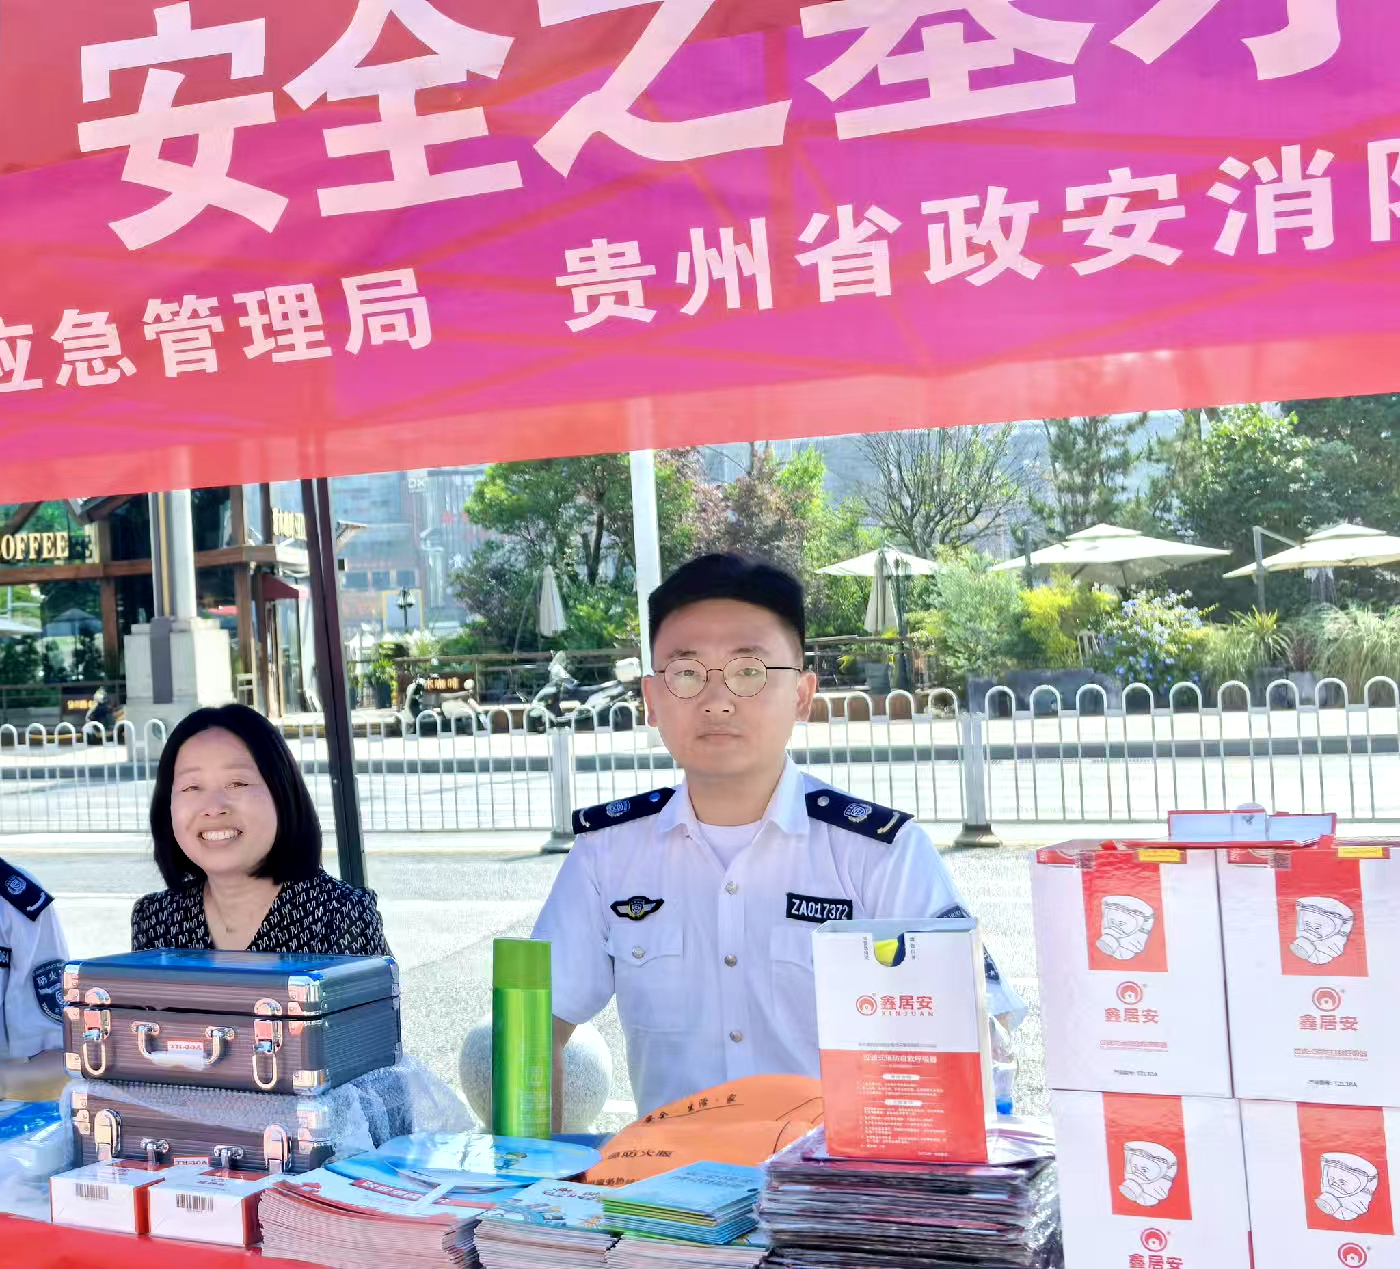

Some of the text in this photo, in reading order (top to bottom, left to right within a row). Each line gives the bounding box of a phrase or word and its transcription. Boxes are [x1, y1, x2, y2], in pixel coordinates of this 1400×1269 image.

[791, 899, 848, 920] ZA017372
[880, 995, 933, 1010] 鑫居安
[1104, 1007, 1159, 1025] 鑫居安
[1299, 1014, 1359, 1032] 鑫居安
[1128, 1253, 1184, 1269] 鑫居安
